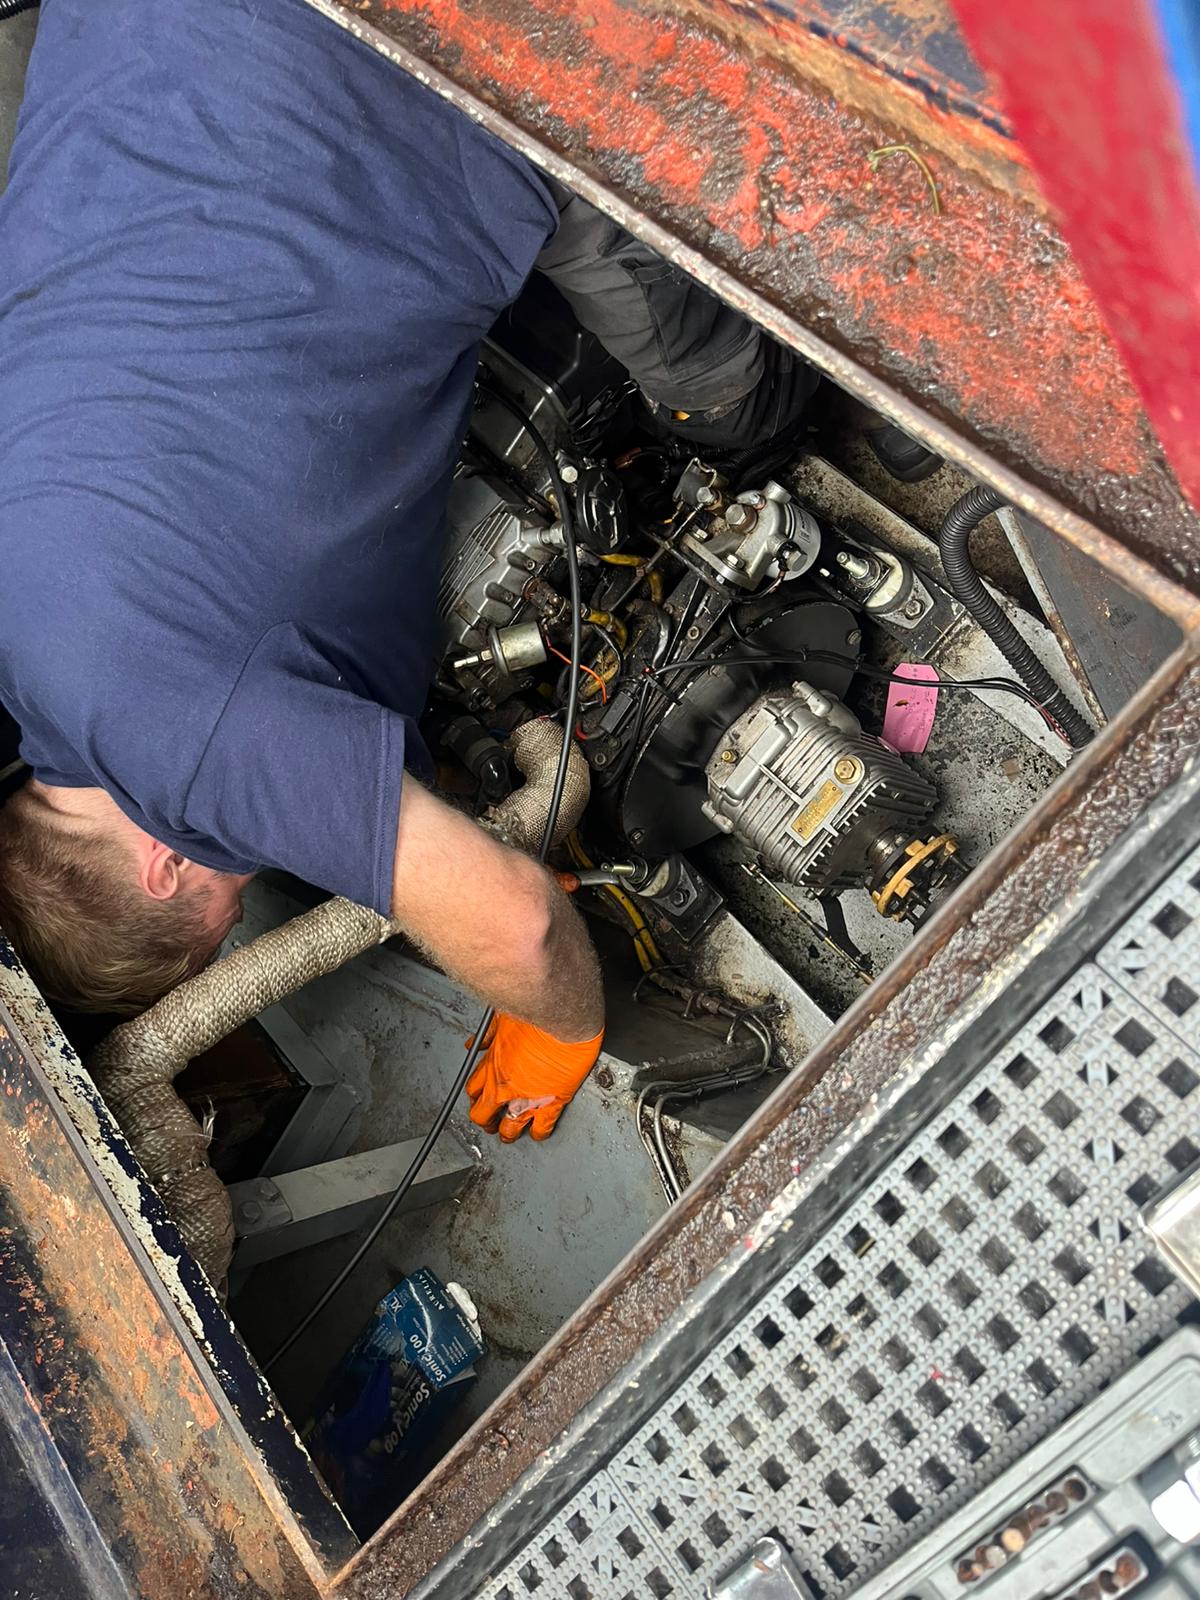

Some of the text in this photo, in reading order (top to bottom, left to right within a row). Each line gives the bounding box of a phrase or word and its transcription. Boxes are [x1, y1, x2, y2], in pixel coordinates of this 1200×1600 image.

[390, 1296, 403, 1313] XL
[418, 1274, 445, 1311] AURELIA
[409, 1334, 427, 1354] 100
[421, 1353, 446, 1382] Sonic
[403, 1382, 430, 1424] Sonic
[384, 1421, 404, 1454] 100
